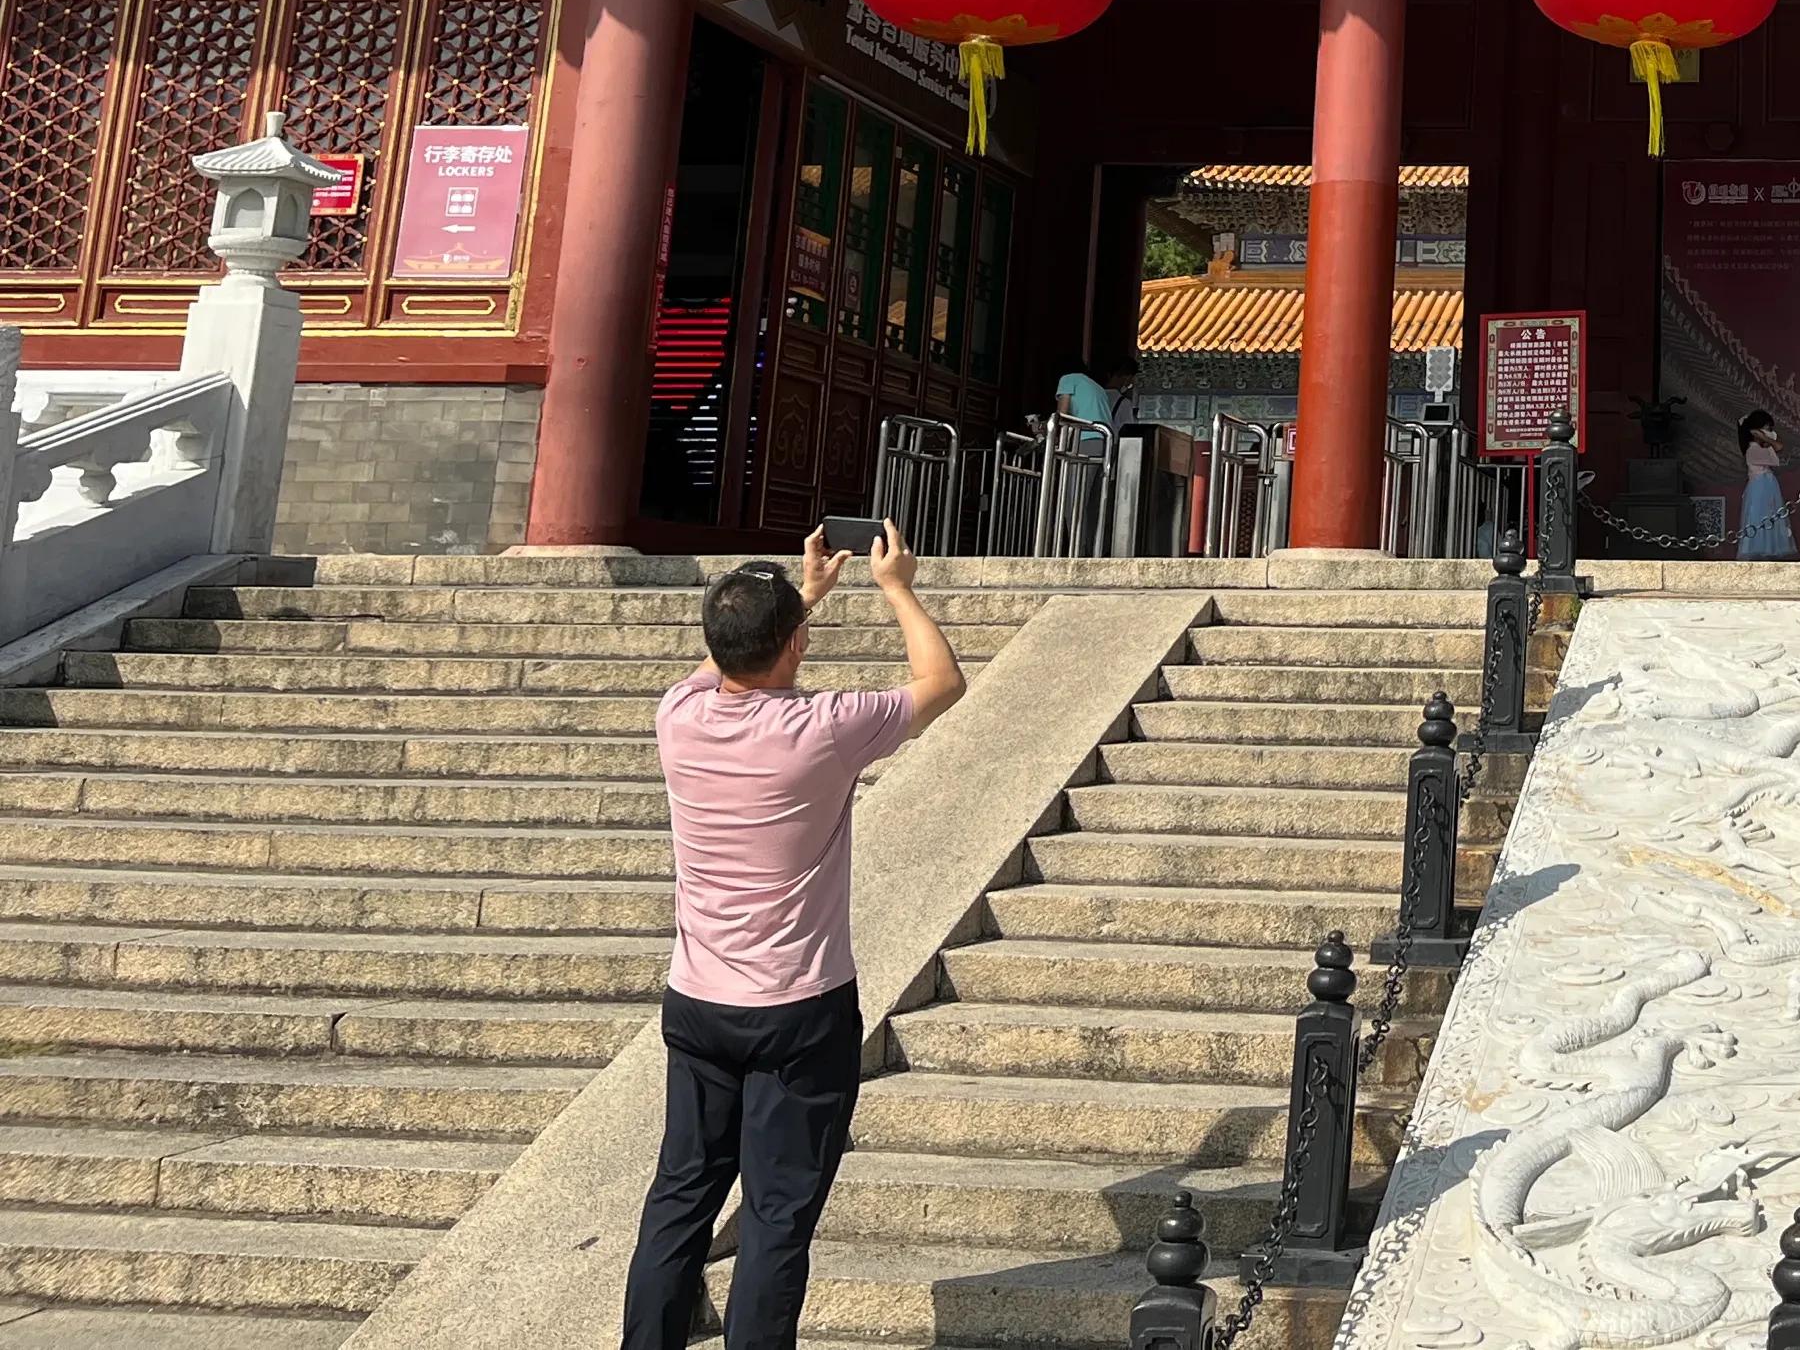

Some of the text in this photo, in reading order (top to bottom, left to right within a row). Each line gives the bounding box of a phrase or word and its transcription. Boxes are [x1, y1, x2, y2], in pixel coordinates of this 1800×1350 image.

[423, 145, 513, 164] 行李寄存处
[438, 166, 495, 178] LOCKERS
[1521, 328, 1546, 340] 公告
